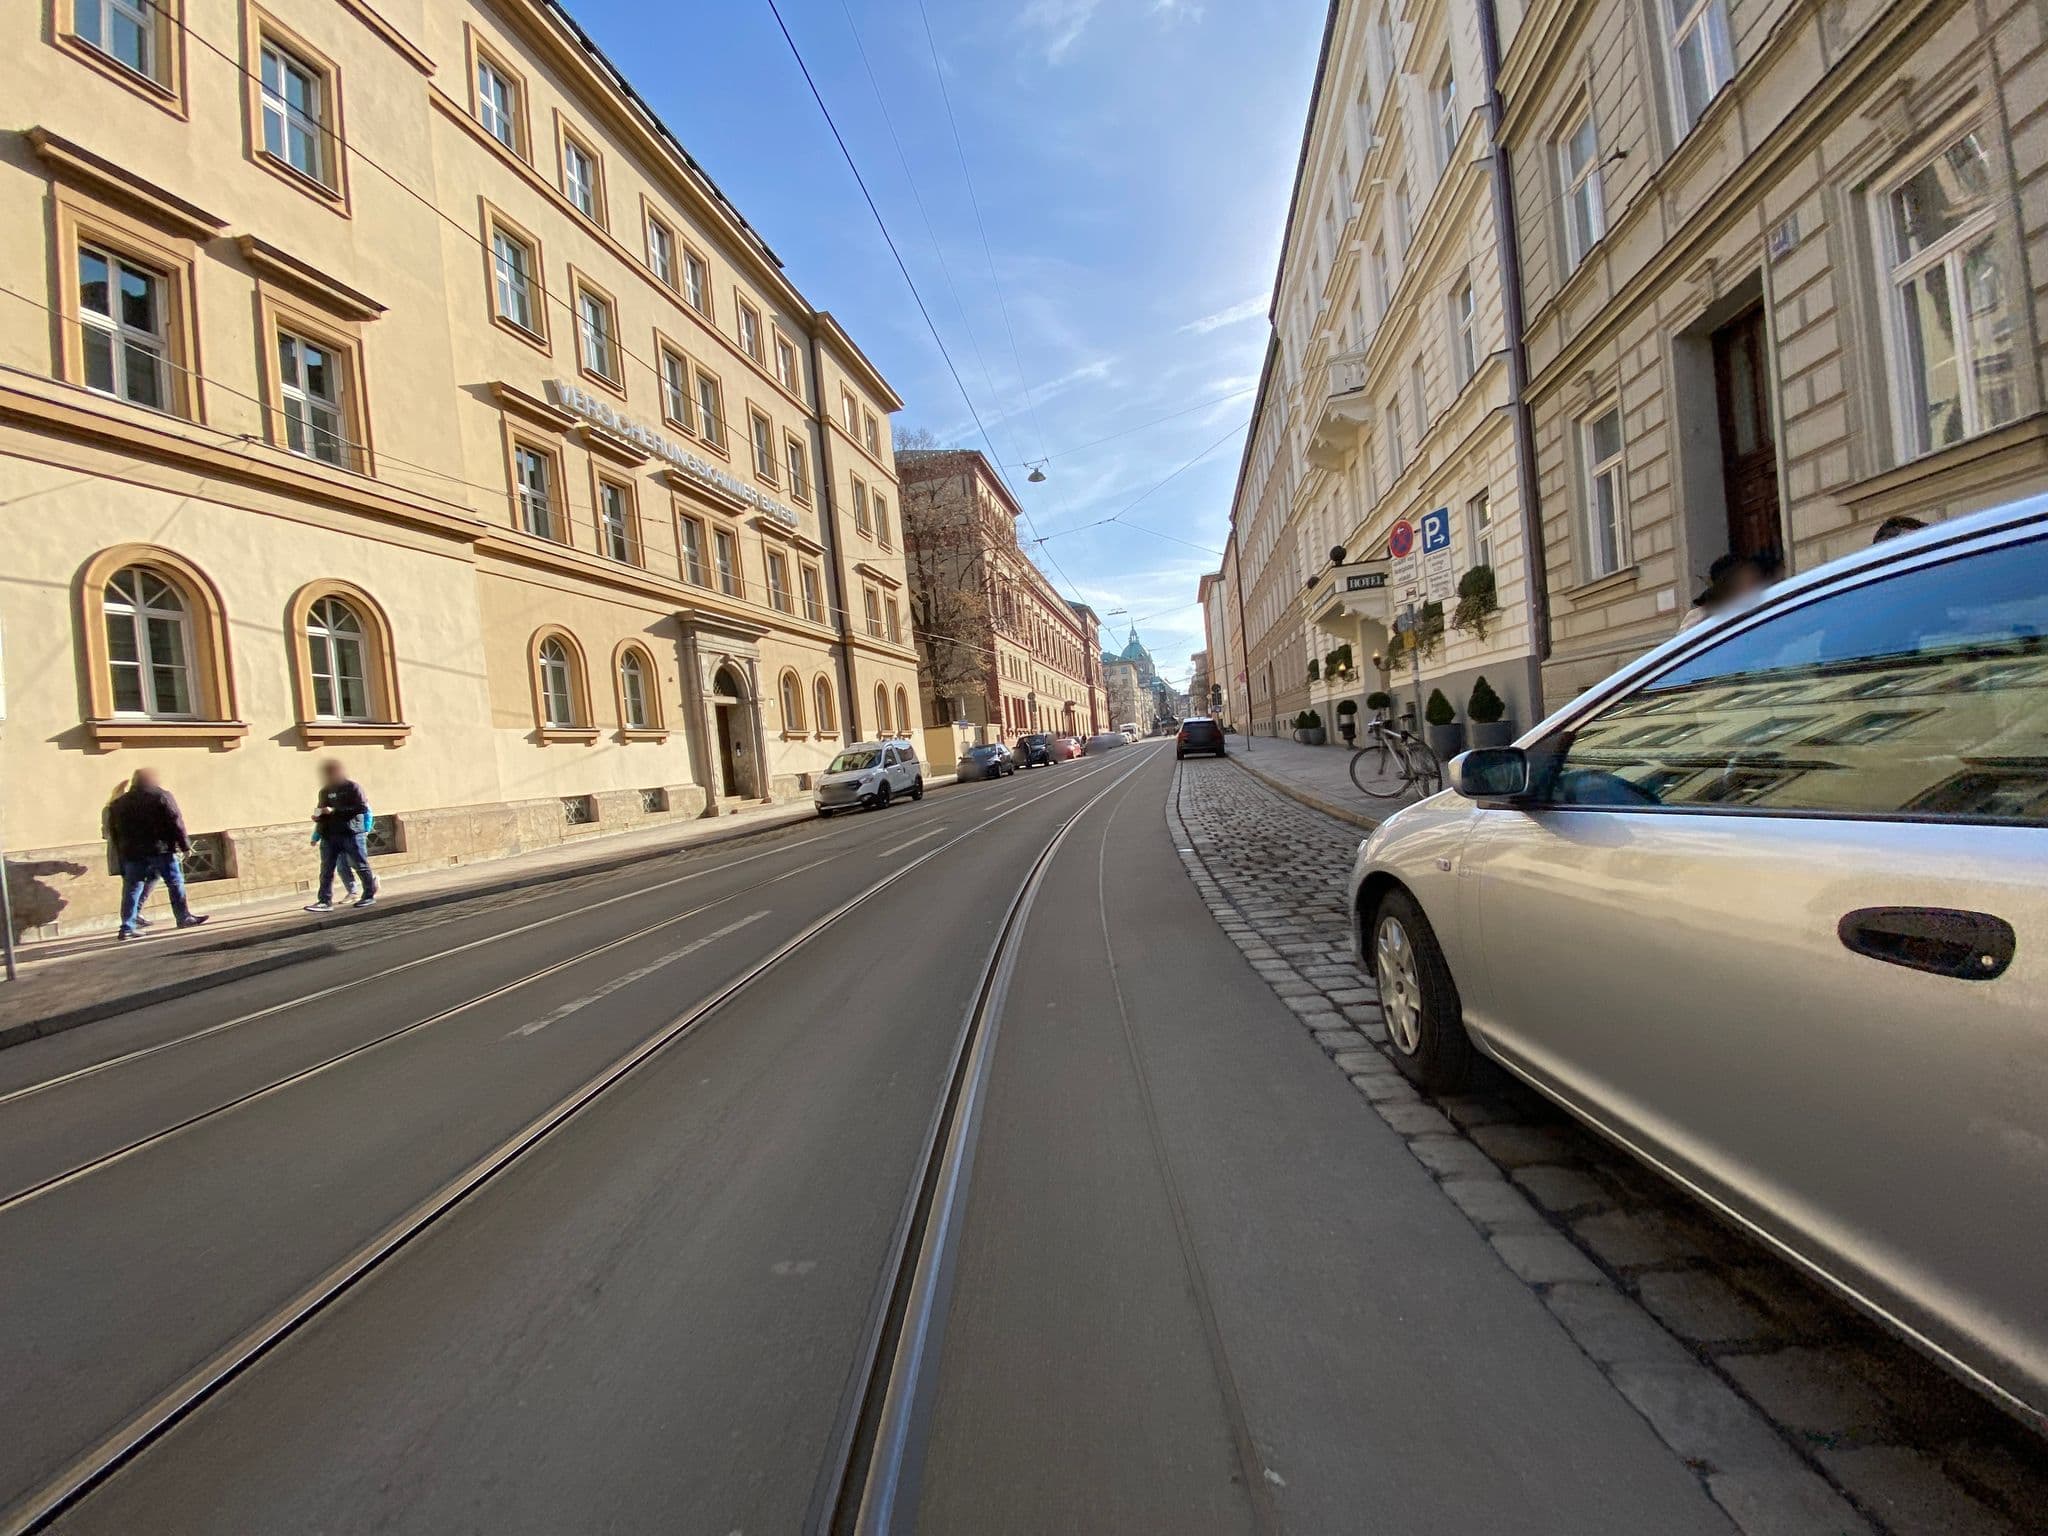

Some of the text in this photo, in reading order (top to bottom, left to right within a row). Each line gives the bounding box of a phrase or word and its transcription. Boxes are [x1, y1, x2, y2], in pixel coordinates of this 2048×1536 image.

[554, 379, 760, 506] VERSICHERUNGSKAMMER
[1425, 517, 1440, 549] P
[1349, 575, 1383, 589] HOTEL
